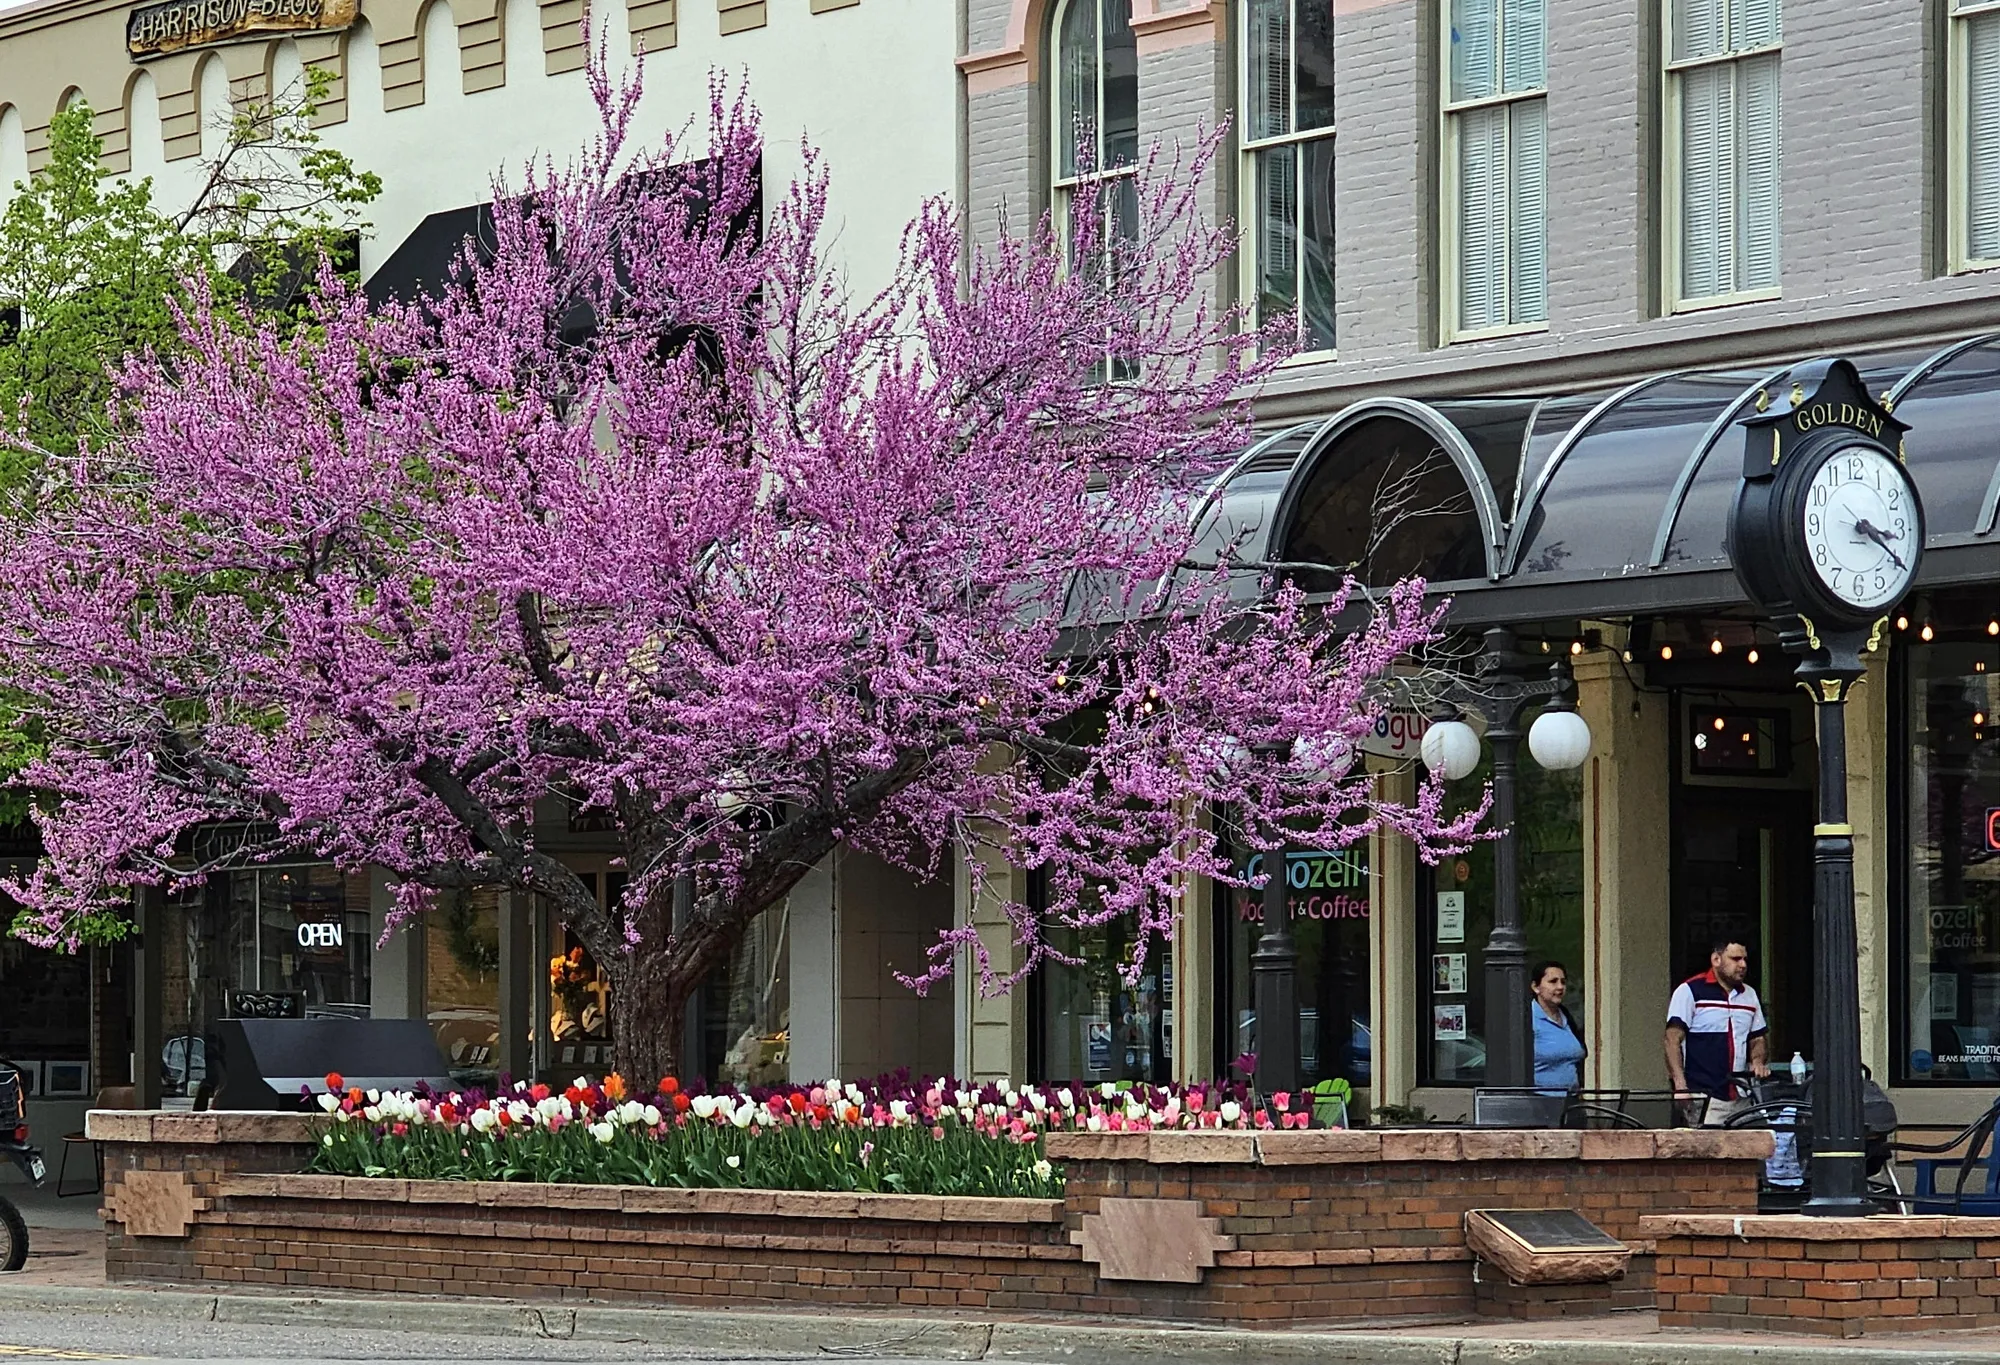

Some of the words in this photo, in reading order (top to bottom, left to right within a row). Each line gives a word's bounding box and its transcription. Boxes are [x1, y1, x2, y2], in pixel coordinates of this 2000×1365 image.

[139, 0, 248, 43] HARRISON
[1797, 402, 1884, 438] GOLDEN
[1828, 465, 1839, 486] 11
[1847, 457, 1864, 480] 12
[1876, 469, 1881, 490] 1
[1813, 485, 1827, 506] 10
[1888, 488, 1899, 510] 2
[1809, 513, 1820, 536] 9
[1895, 518, 1905, 540] 3
[1816, 544, 1827, 566] 8
[1831, 568, 1842, 589] 7
[1853, 574, 1864, 596] 6
[1874, 568, 1885, 589] 5
[1298, 901, 1306, 915] &
[1308, 895, 1369, 919] Coffee
[298, 923, 343, 946] OPEN
[1943, 932, 1987, 948] Coffee
[1938, 1055, 1959, 1063] BEANS
[1960, 1055, 1991, 1063] IMPORTED
